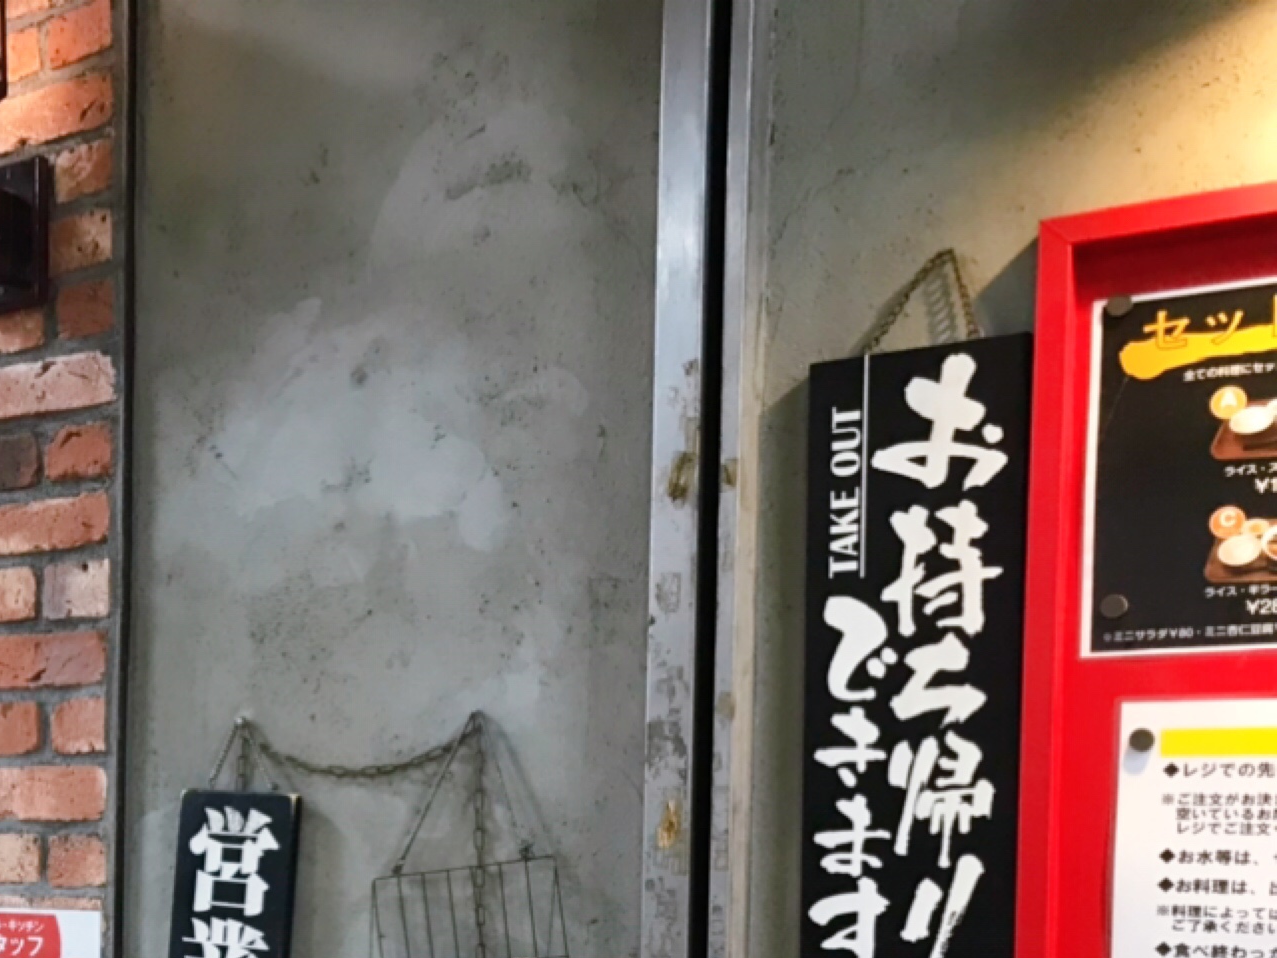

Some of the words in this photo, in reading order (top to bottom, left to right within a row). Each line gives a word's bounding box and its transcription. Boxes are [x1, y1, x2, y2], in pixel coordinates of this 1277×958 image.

[1142, 293, 1277, 350] セッ
[1220, 390, 1238, 408] A
[830, 406, 862, 475] OUT
[828, 486, 862, 579] TAKE
[1219, 510, 1236, 528] C
[1176, 821, 1277, 836] レジでご注文
